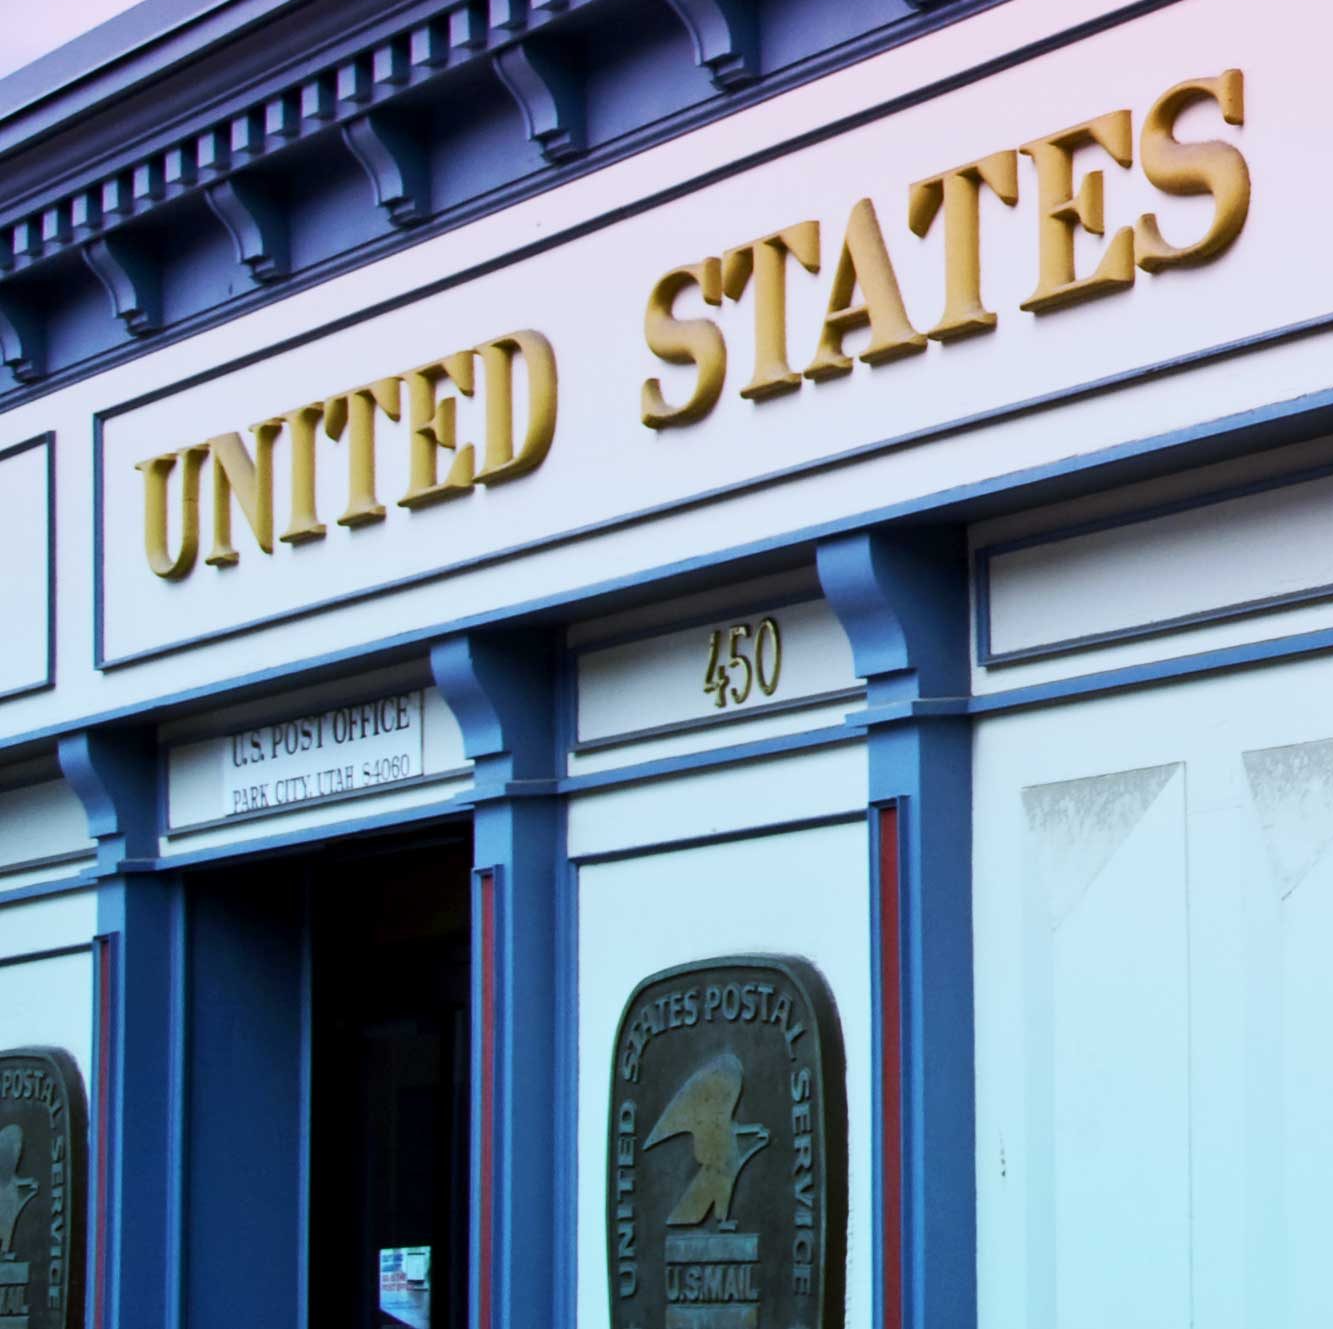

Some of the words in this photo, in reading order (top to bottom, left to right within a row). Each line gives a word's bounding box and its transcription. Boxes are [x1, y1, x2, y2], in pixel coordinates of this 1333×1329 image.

[135, 329, 558, 579] UNITED
[641, 68, 1251, 429] STATES
[704, 617, 782, 708] 450
[232, 733, 265, 768] U.S.
[272, 714, 323, 759] POST
[332, 694, 411, 744] OFFICE
[232, 783, 270, 814] PARK
[317, 765, 355, 797] UTAH
[622, 987, 699, 1083] STATES
[704, 983, 805, 1062] POSTAL
[617, 1098, 637, 1299] UNITED
[791, 1068, 815, 1297] SERVICE
